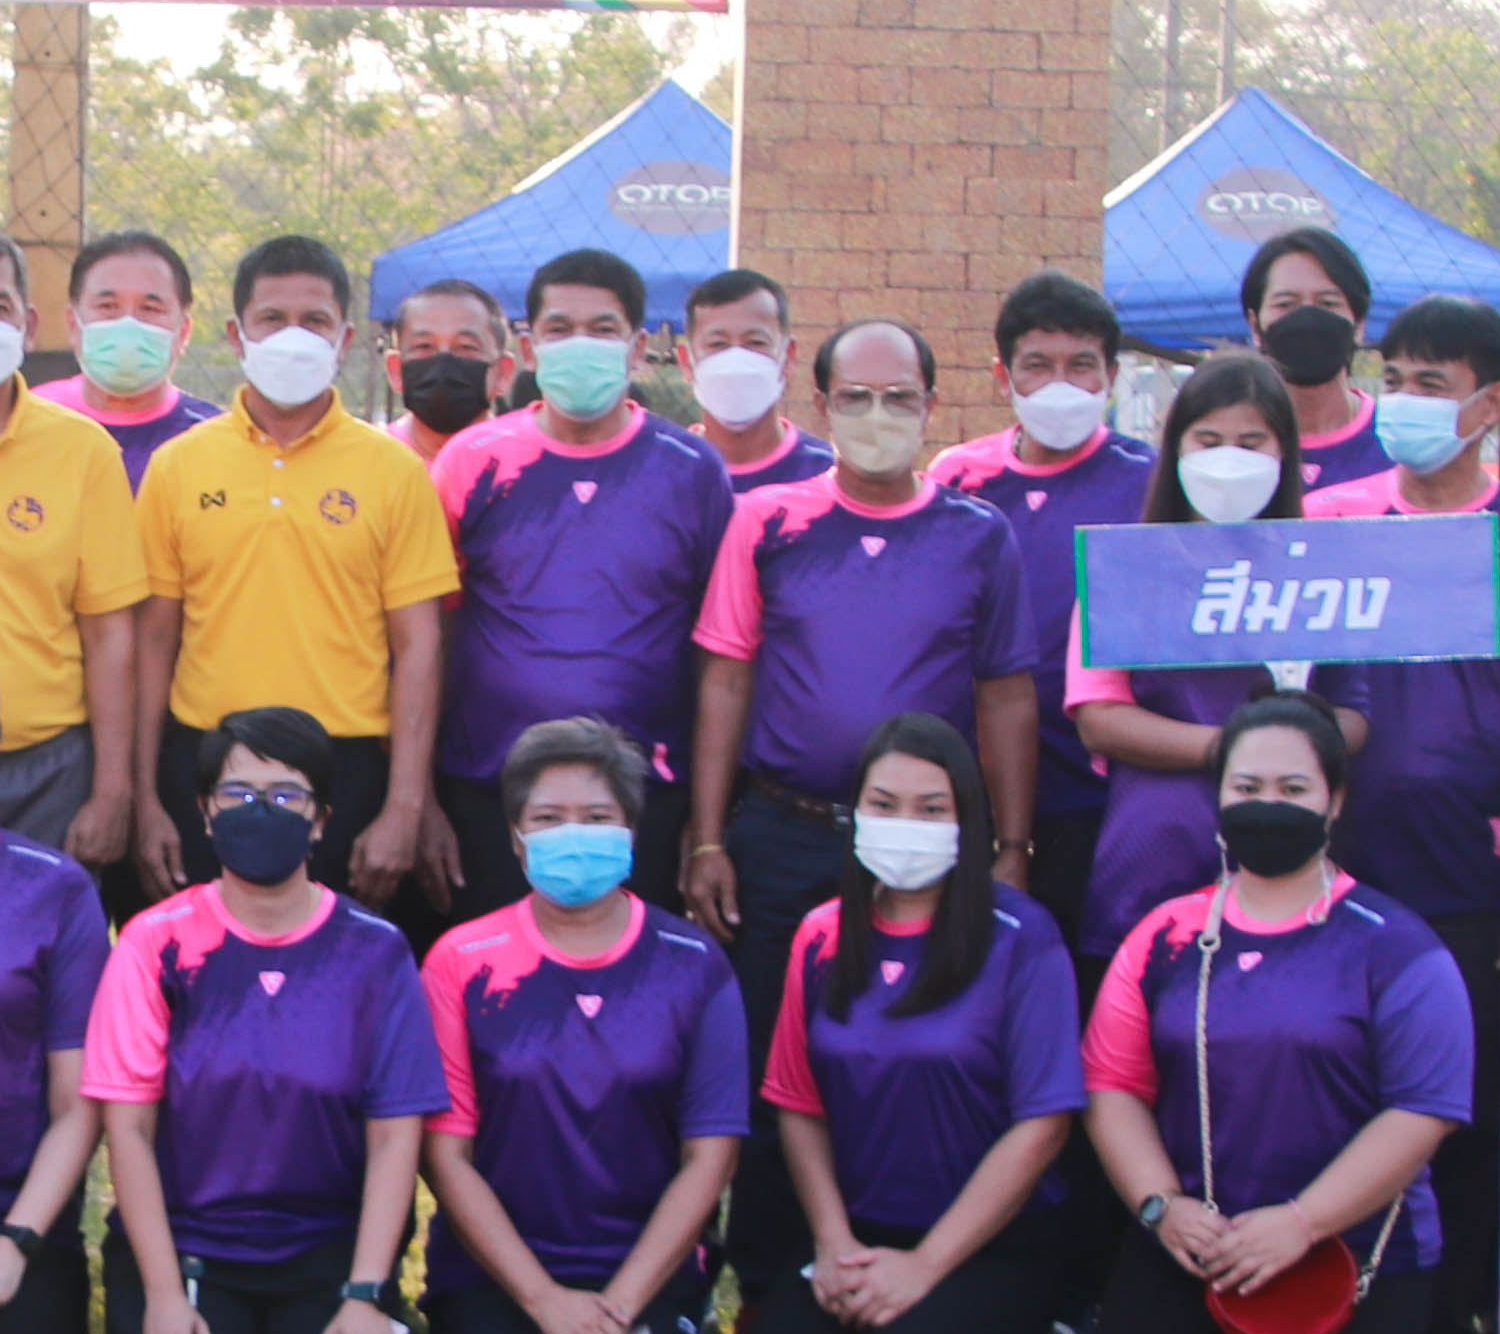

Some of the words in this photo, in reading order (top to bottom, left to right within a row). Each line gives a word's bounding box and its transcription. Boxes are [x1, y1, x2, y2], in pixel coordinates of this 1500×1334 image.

[1206, 191, 1323, 215] OTOP
[1192, 542, 1391, 635] สีม่วง
